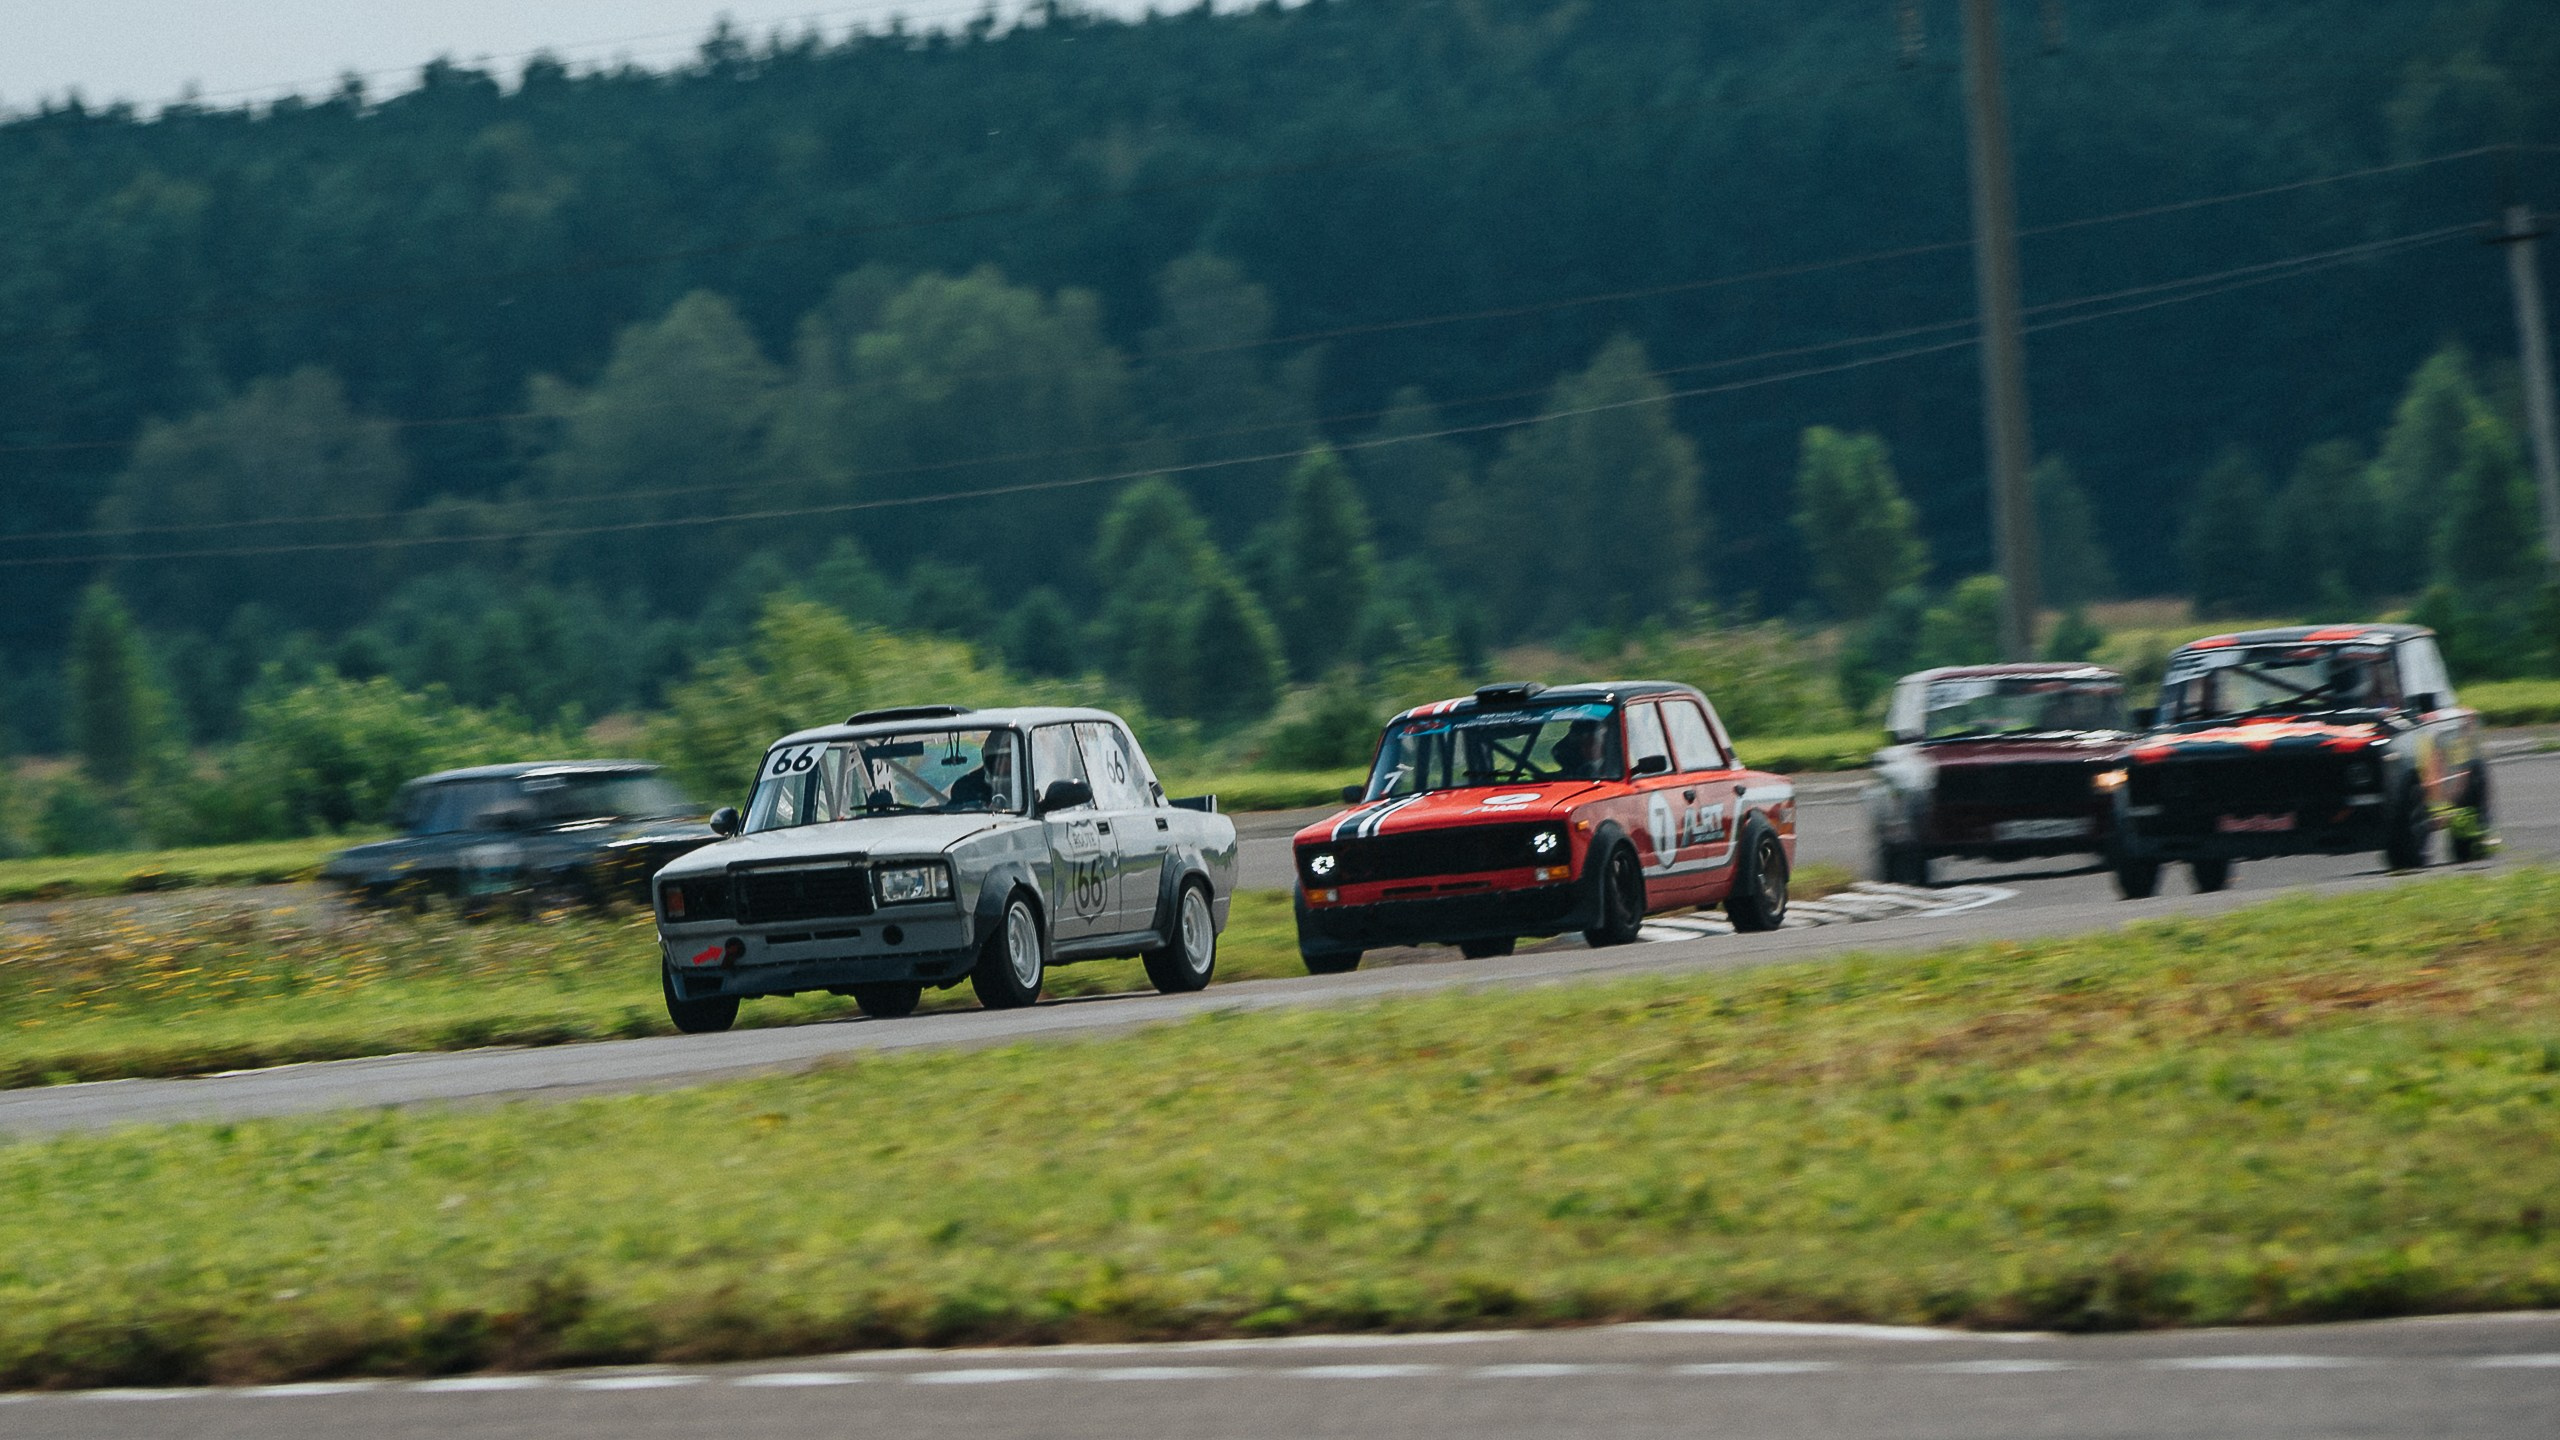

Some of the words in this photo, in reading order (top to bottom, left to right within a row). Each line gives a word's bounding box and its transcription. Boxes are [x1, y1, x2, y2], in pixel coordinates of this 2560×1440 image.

[772, 745, 815, 776] 66
[1105, 749, 1126, 785] 66
[1078, 858, 1103, 909] 66
